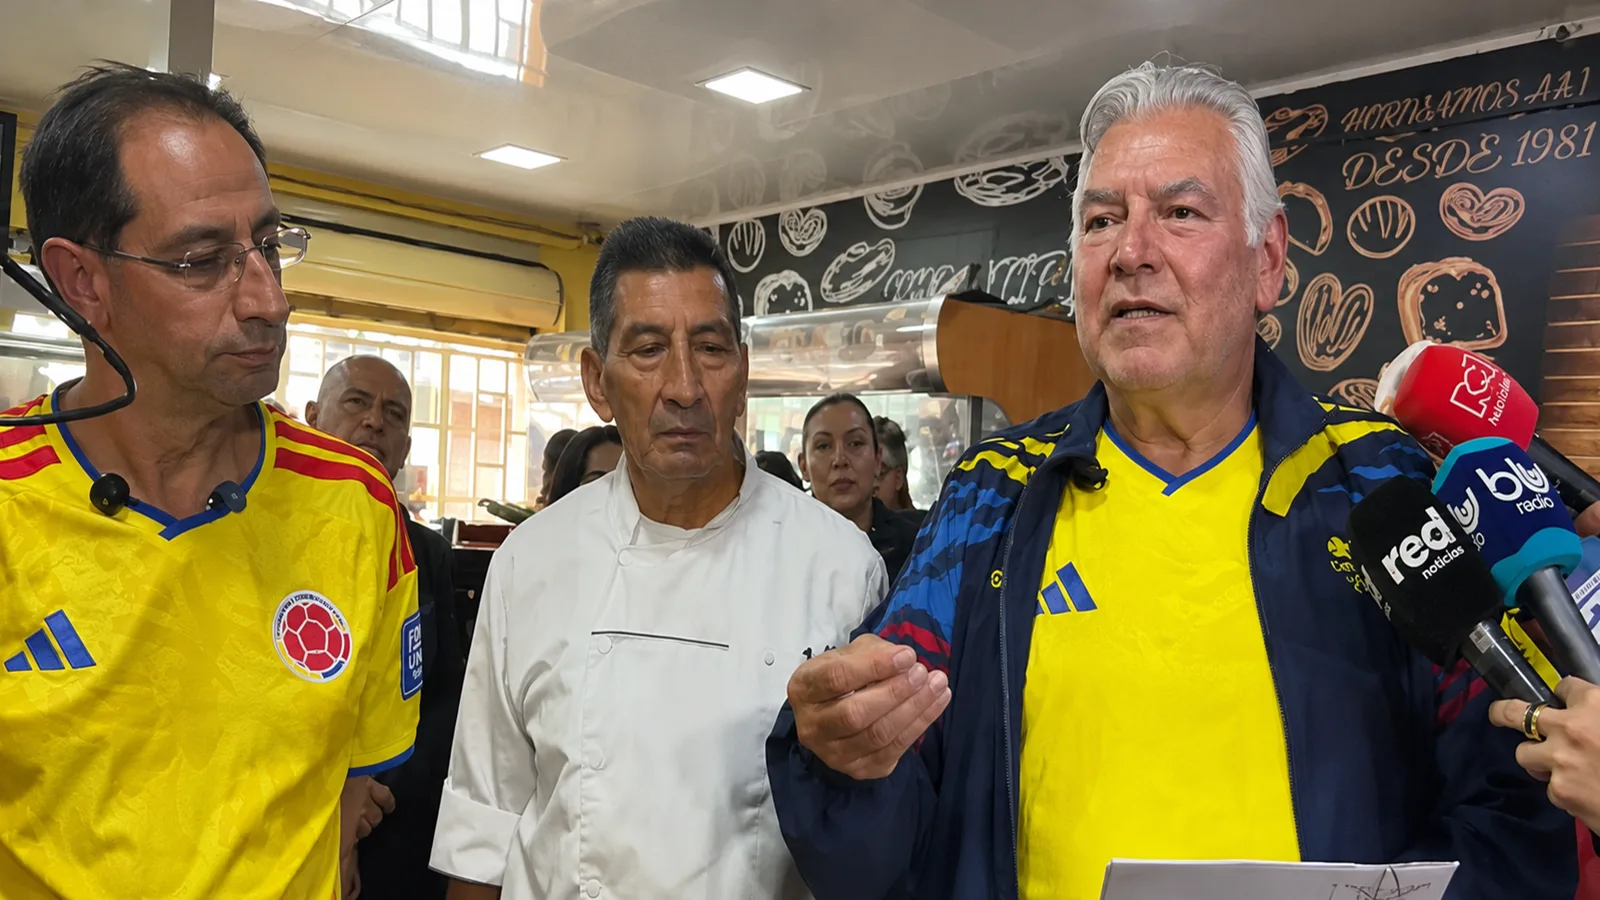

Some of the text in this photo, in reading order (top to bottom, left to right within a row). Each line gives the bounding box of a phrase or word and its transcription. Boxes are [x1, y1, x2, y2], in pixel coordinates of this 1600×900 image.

[1342, 121, 1597, 190] DESDE 1981
[1515, 492, 1554, 515] radio
[1381, 506, 1457, 585] red
[1421, 545, 1465, 579] noticias
